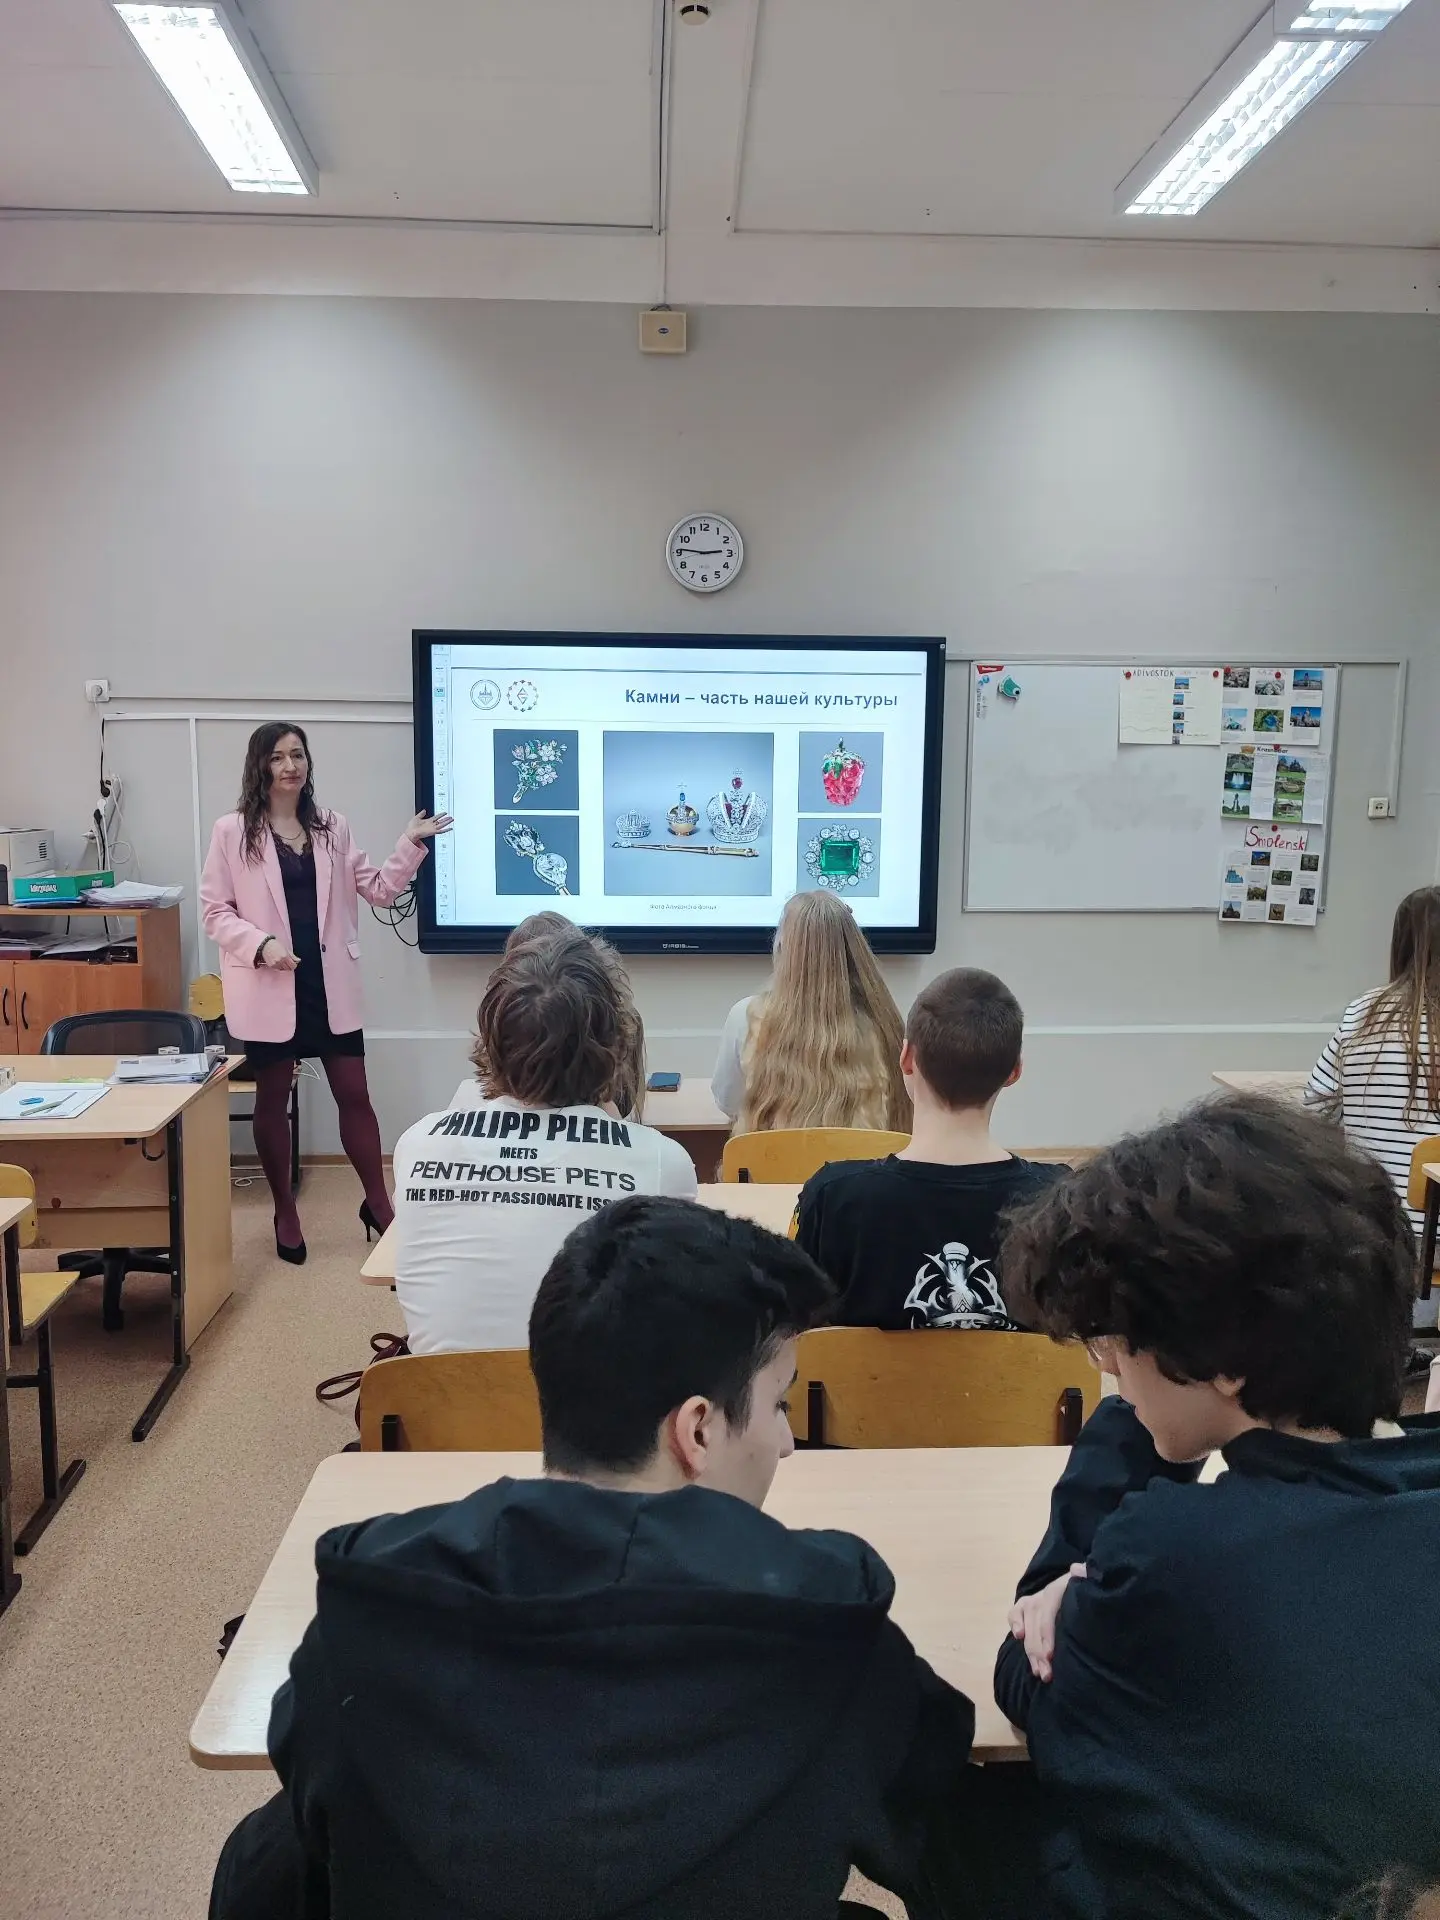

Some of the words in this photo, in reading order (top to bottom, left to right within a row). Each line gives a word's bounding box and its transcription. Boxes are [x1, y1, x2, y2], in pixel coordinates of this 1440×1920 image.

[689, 527, 696, 535] 11
[700, 523, 710, 531] 12
[716, 527, 720, 535] 1
[680, 536, 690, 544] 10
[723, 536, 730, 544] 2
[676, 549, 683, 557] 9
[726, 549, 733, 557] 3
[680, 561, 687, 569] 8
[722, 562, 729, 570] 4
[689, 571, 696, 579] 7
[701, 574, 708, 583] 6
[714, 571, 721, 579] 5
[625, 688, 680, 704] Камни
[700, 692, 749, 705] часть
[754, 690, 809, 705] нашей
[814, 693, 898, 709] культуры
[1245, 825, 1305, 851] Smolensk
[427, 1110, 541, 1140] PHILIPP
[546, 1113, 632, 1148] PLEIN
[499, 1146, 538, 1160] MEETS
[566, 1167, 636, 1192] PETS
[405, 1188, 427, 1202] THE
[429, 1188, 491, 1202] RED-HOT
[492, 1191, 584, 1209] PASSIONATE
